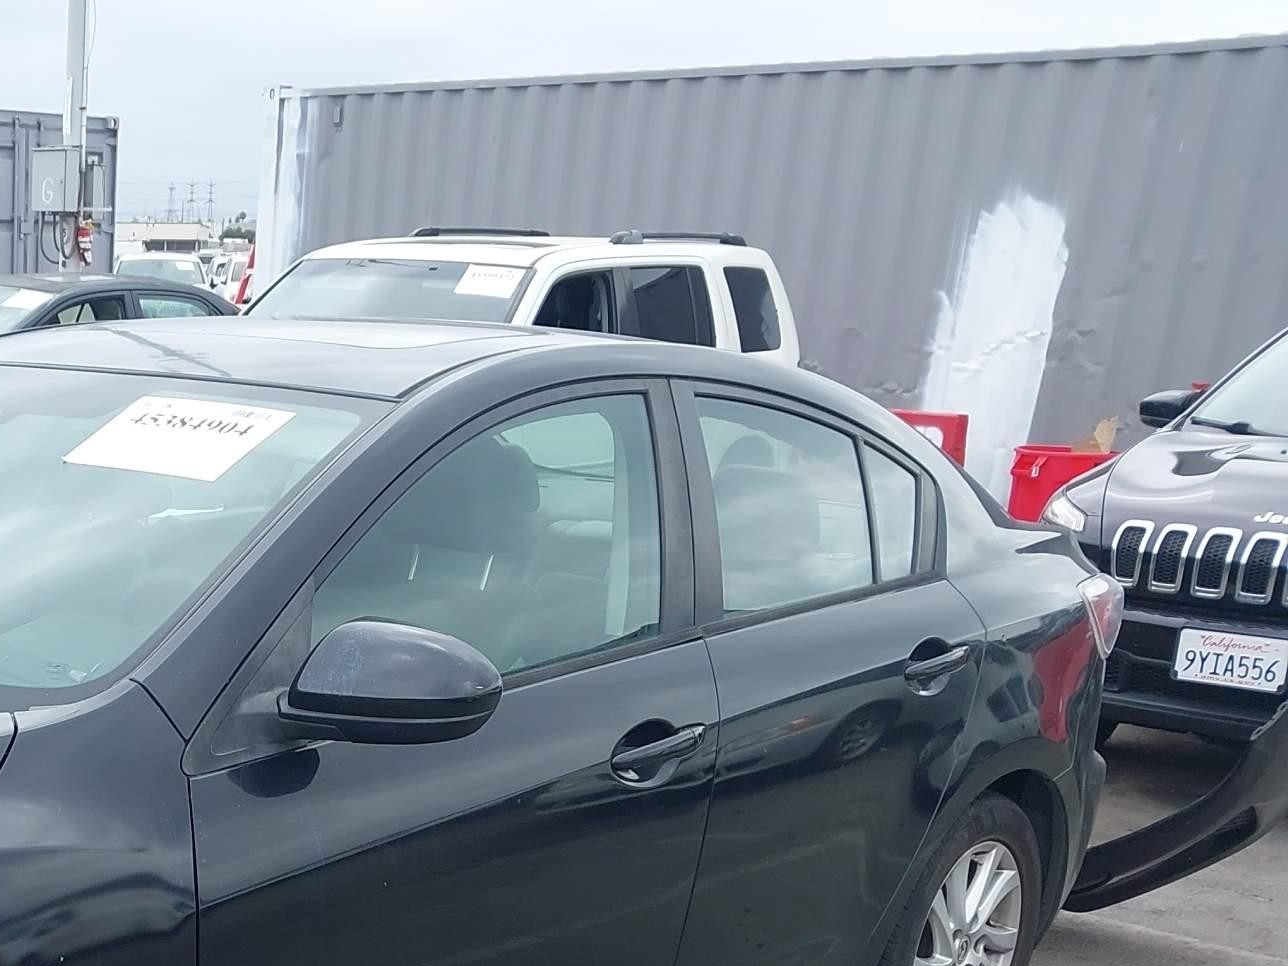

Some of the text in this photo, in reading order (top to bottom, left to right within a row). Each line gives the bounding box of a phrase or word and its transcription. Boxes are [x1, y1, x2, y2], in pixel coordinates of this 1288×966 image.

[41, 177, 54, 204] G
[1202, 635, 1269, 654] California
[1182, 649, 1280, 682] 9YIA556
